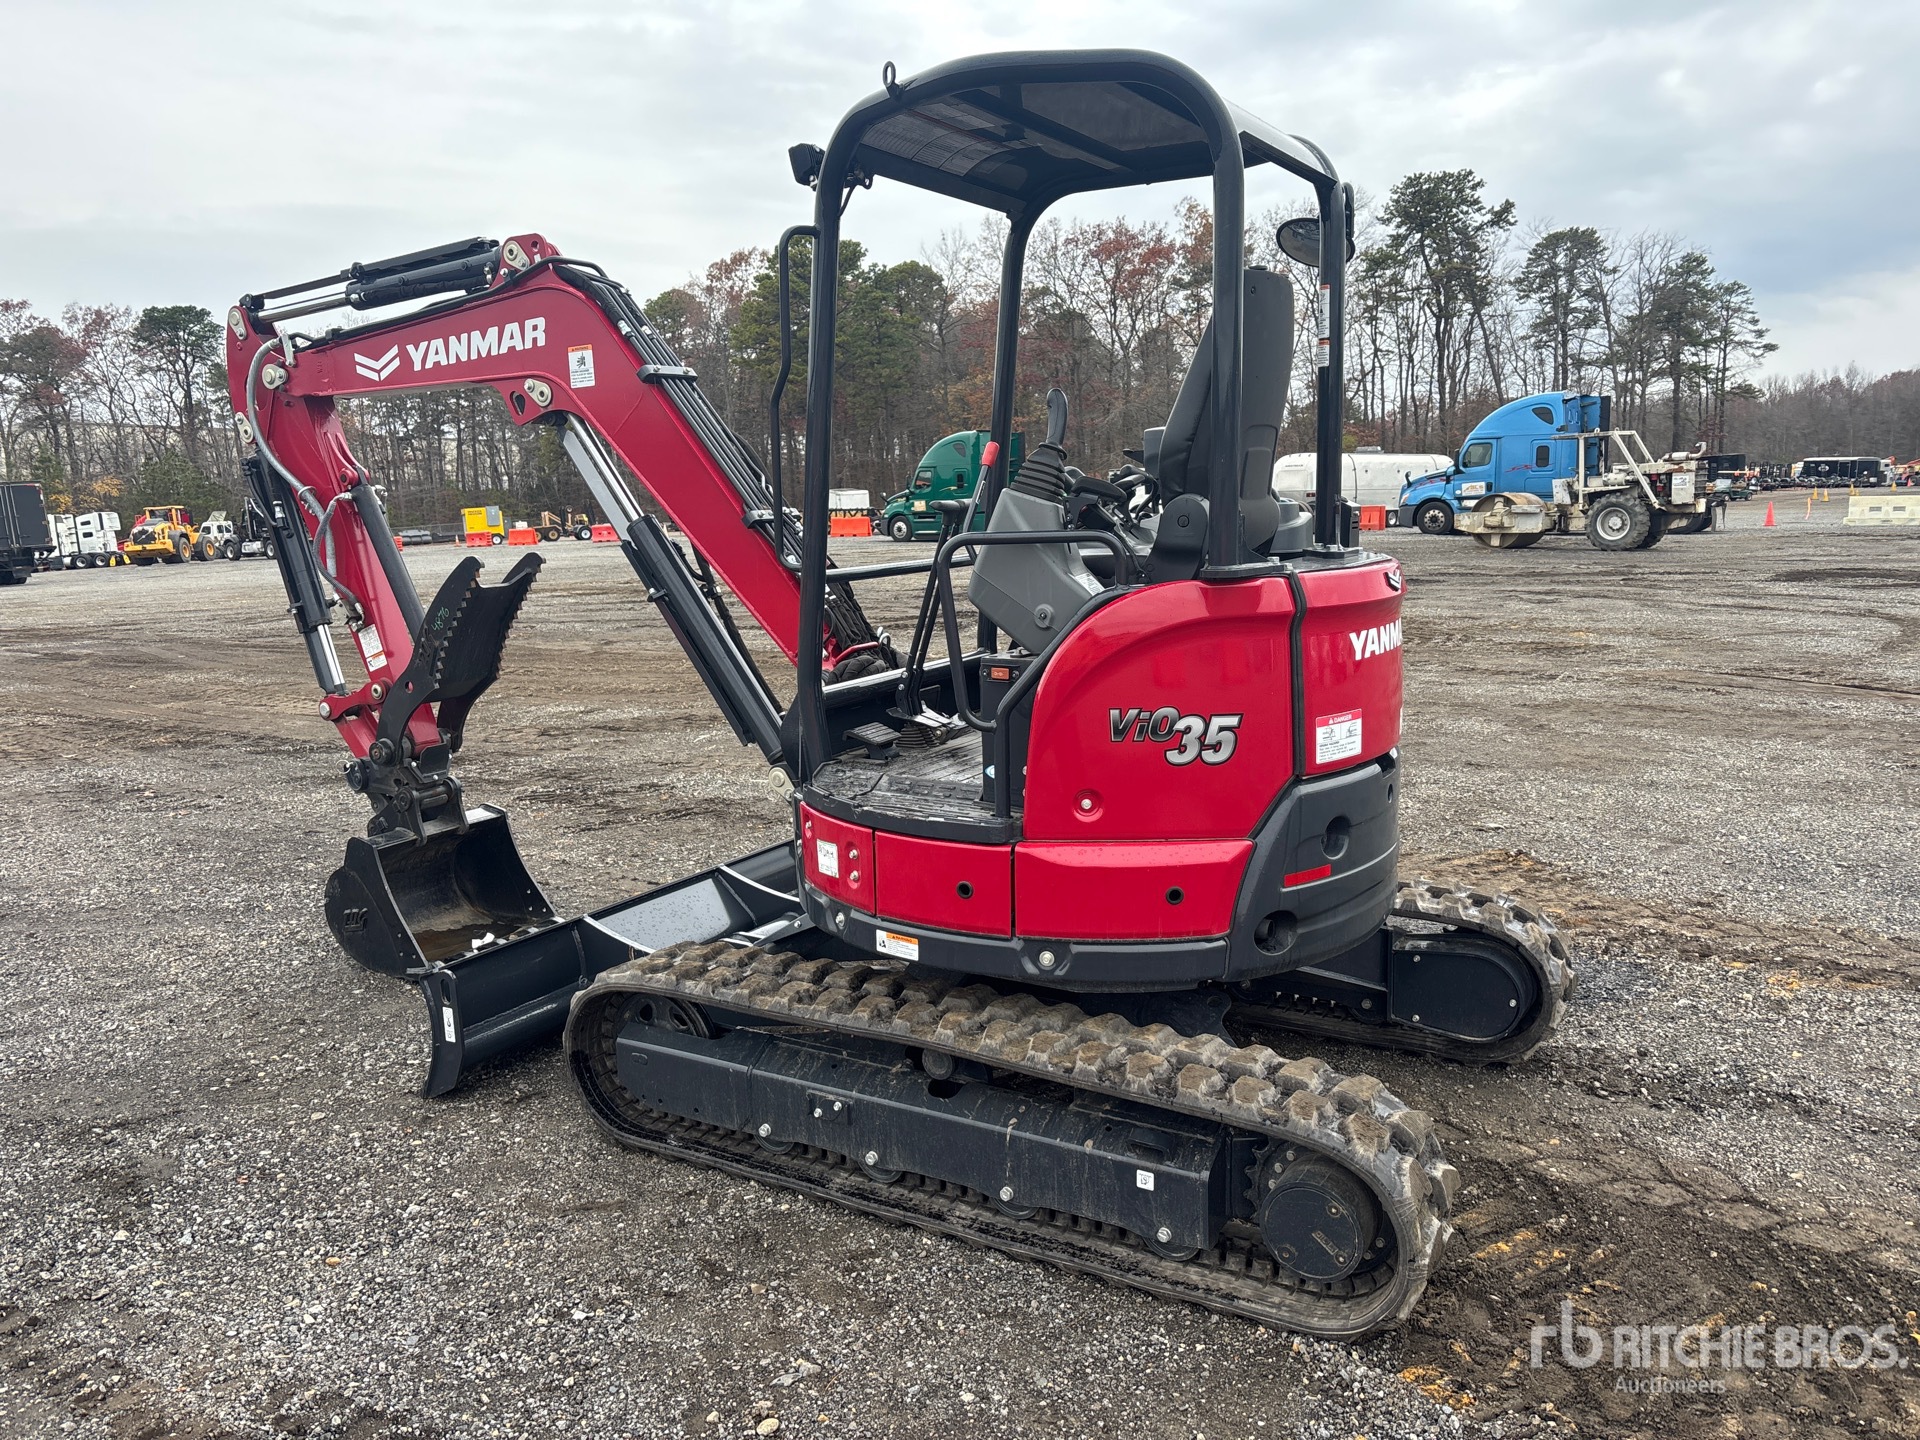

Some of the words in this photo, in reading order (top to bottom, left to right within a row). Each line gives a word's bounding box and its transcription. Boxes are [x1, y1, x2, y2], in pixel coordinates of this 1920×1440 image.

[406, 316, 546, 371] YANMAR
[430, 606, 450, 631] 4876
[1333, 714, 1353, 723] DANGER
